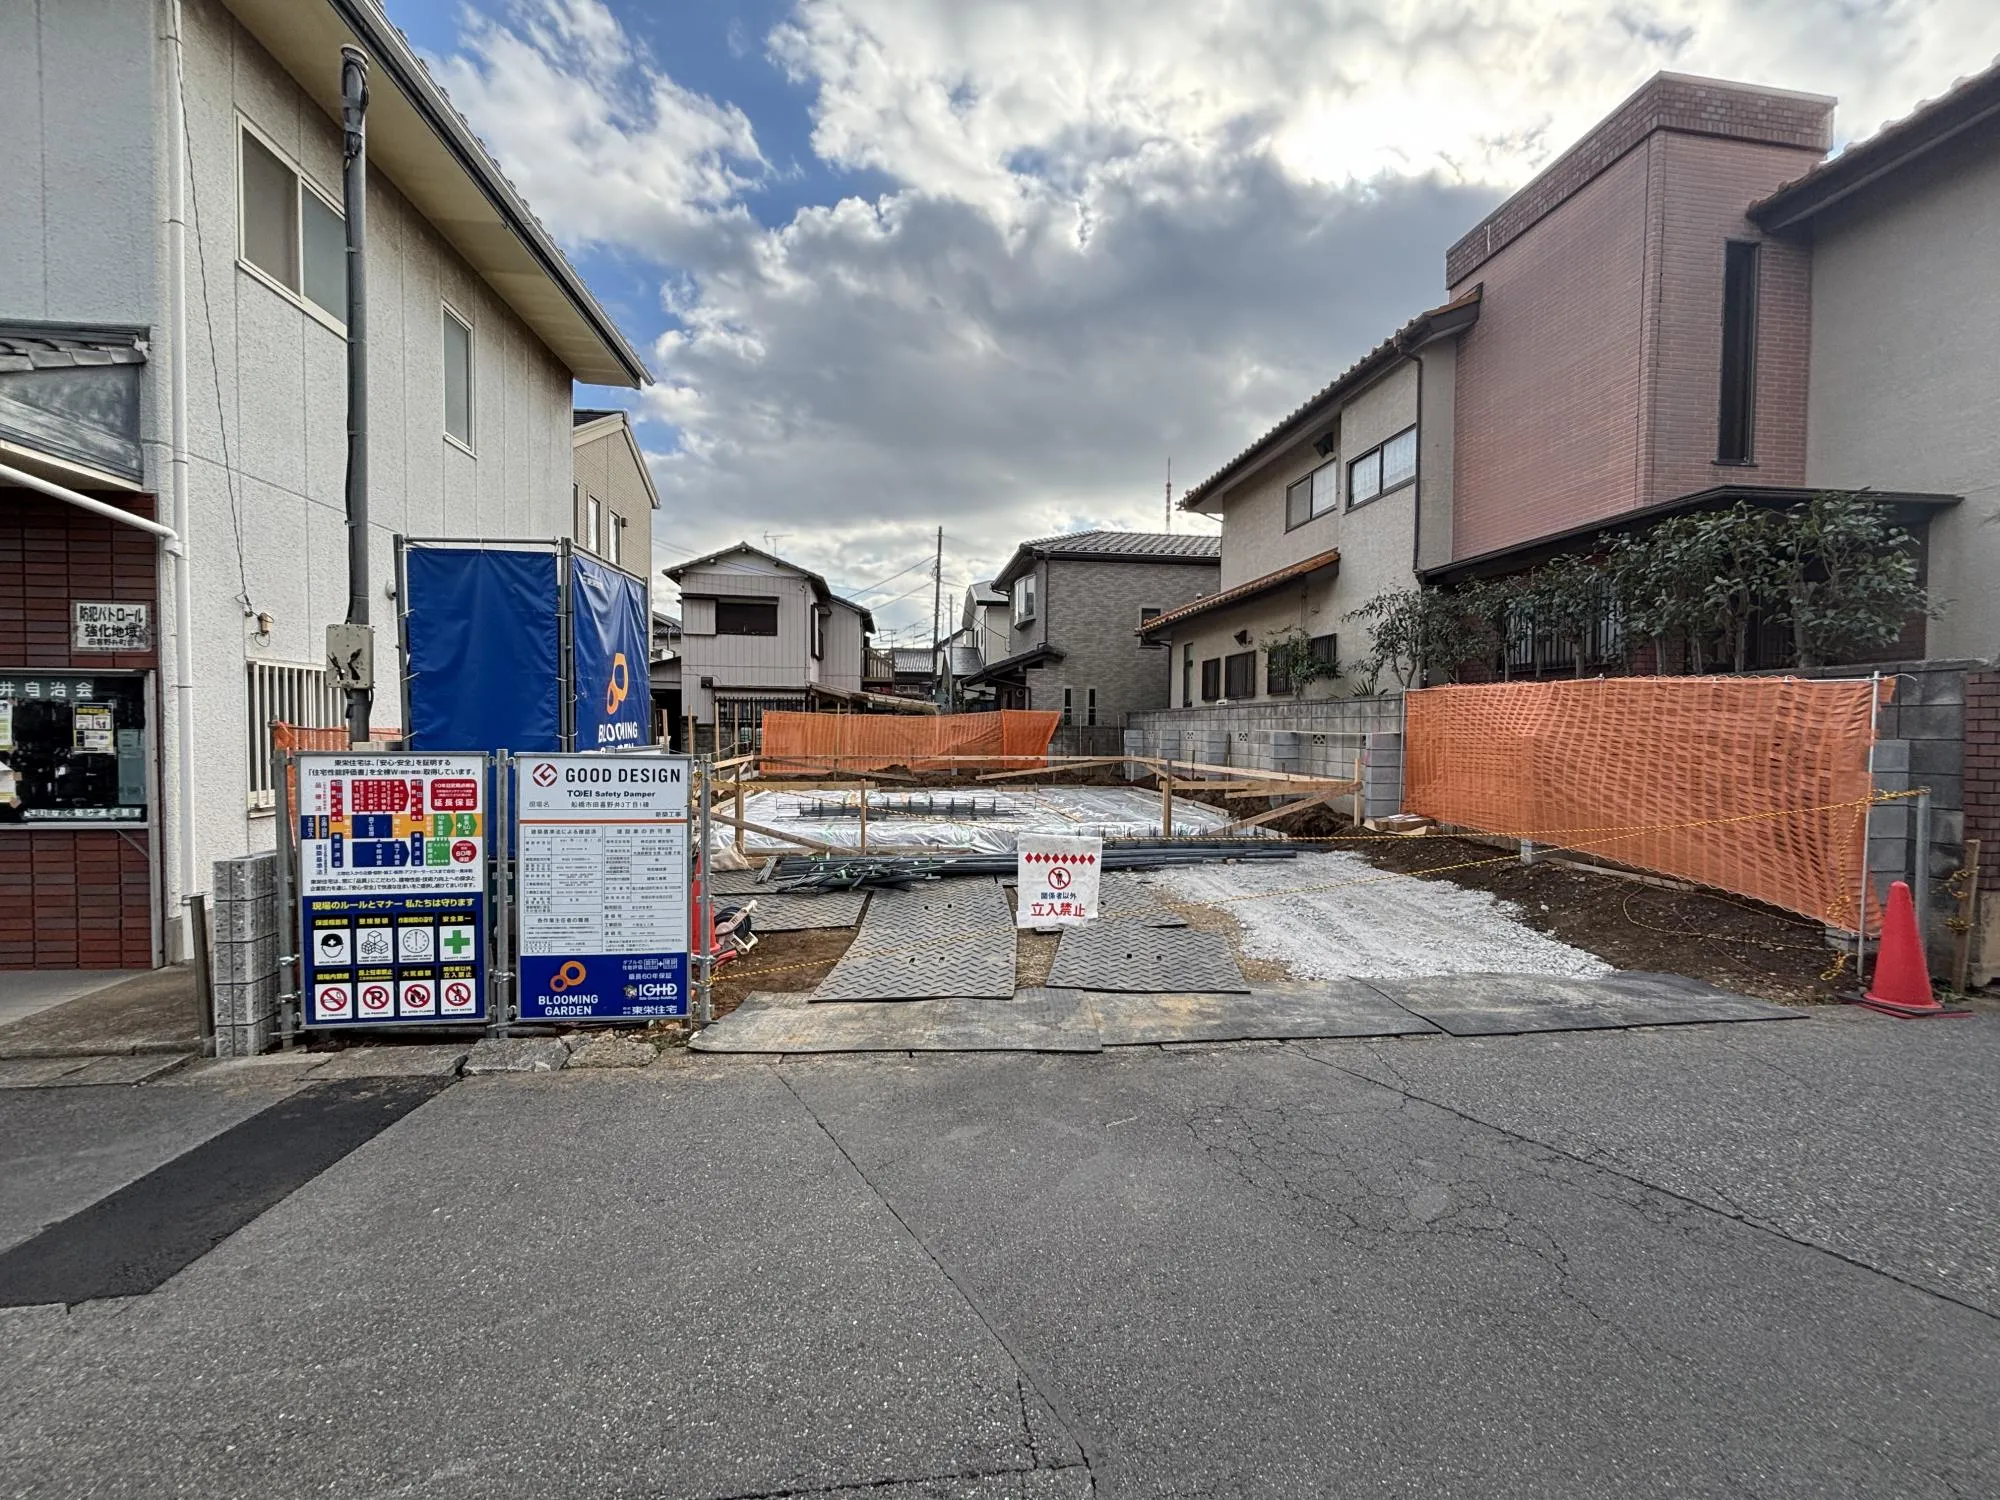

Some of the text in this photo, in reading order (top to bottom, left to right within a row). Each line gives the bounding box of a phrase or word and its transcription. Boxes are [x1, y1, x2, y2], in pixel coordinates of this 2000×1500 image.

[79, 605, 143, 622] 防犯パトロール
[85, 623, 138, 638] 強化地域
[0, 682, 93, 698] 井自治会
[565, 768, 680, 783] GOOD DESIGN
[1040, 892, 1077, 900] 関係者以外
[405, 898, 475, 908] 私たちは守ります
[1031, 903, 1086, 917] 立入禁止
[538, 994, 599, 1005] BLOOMING
[545, 1005, 592, 1015] GARDEN
[632, 1005, 677, 1015] 東栄住宅
